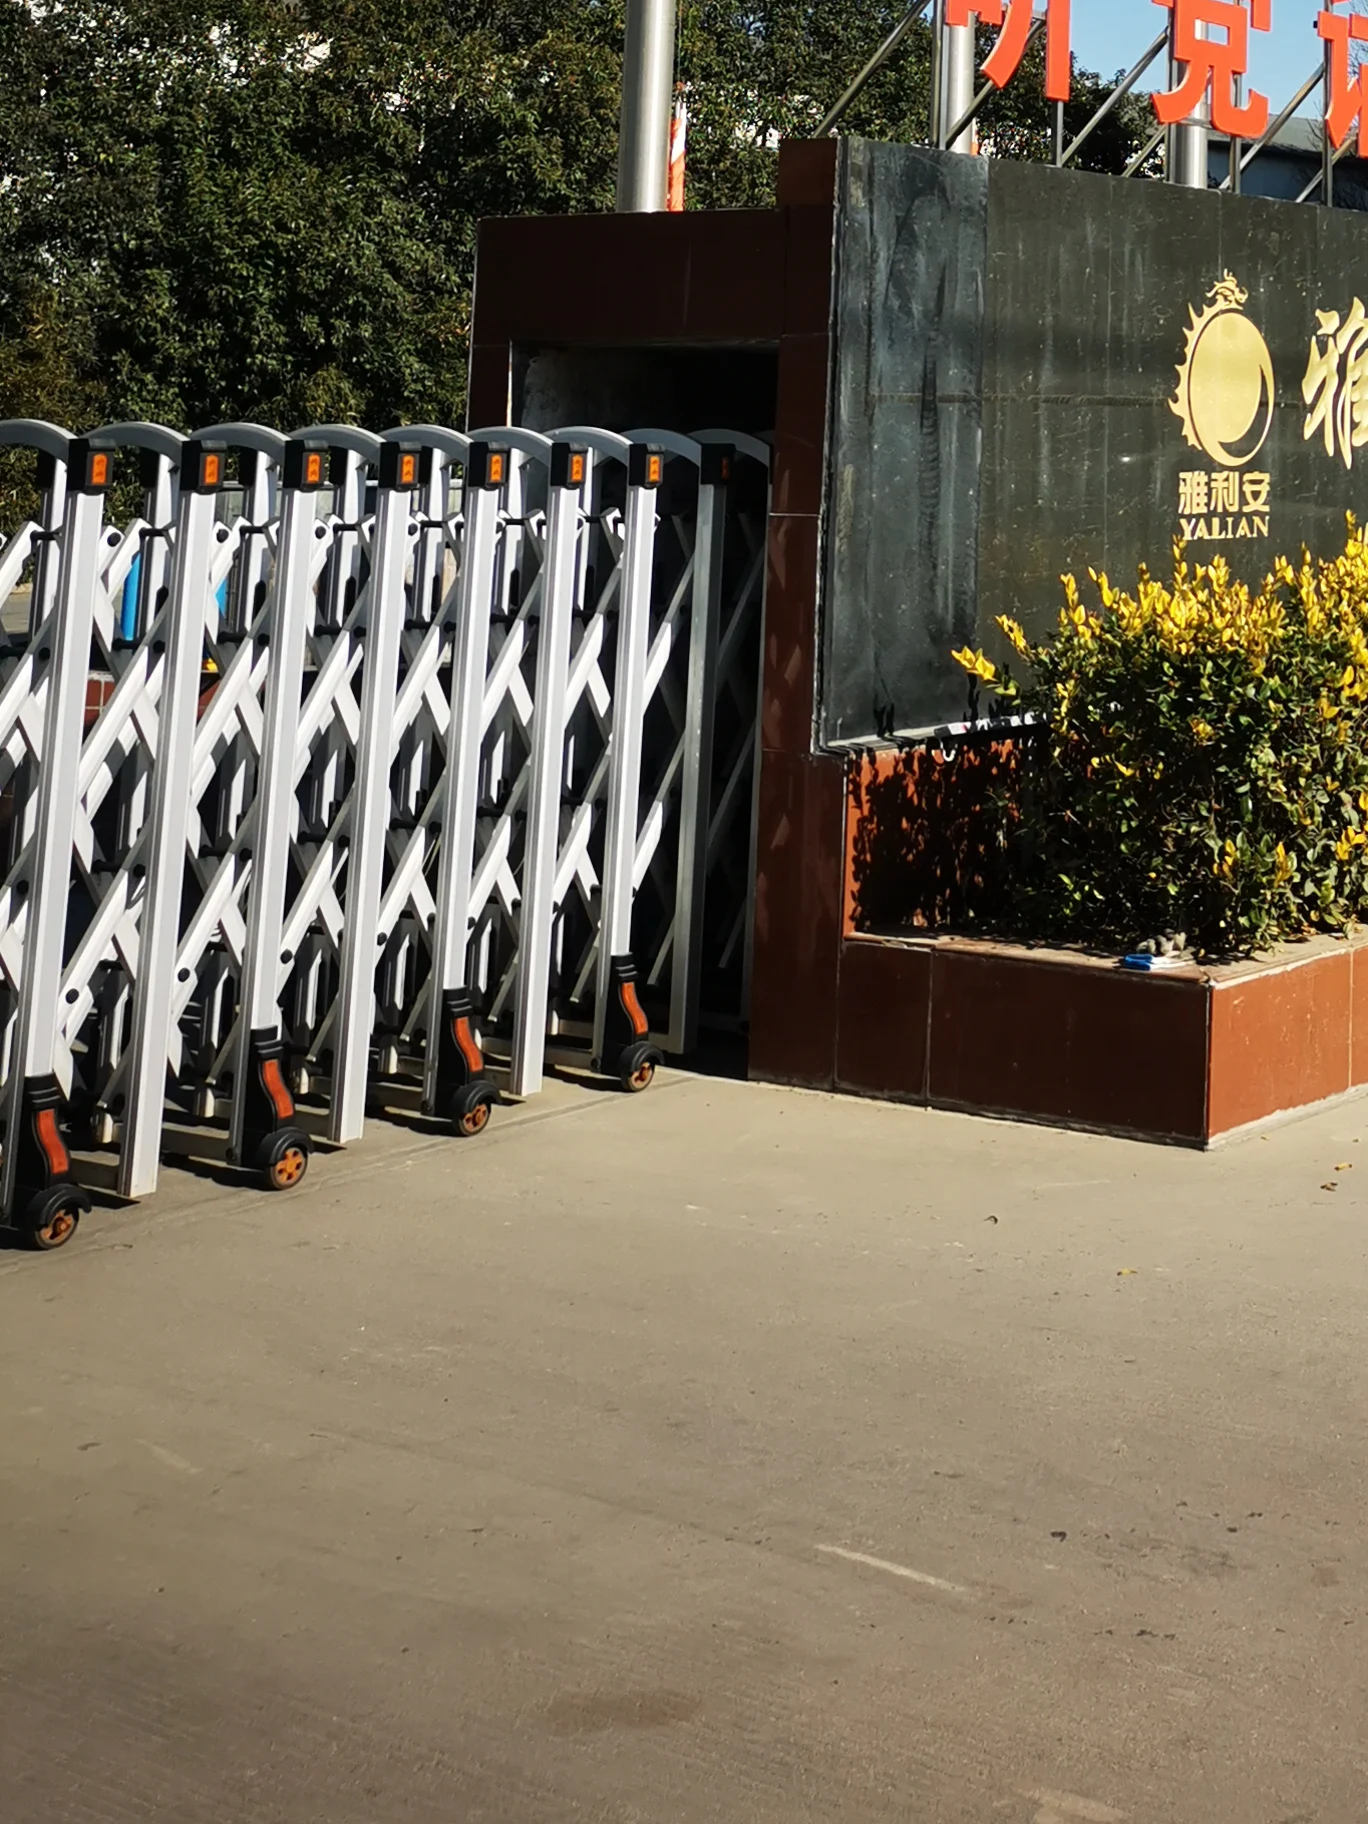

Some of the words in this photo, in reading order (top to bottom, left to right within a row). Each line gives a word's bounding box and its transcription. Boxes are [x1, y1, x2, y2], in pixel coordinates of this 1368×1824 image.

[1178, 471, 1271, 515] 雅利安
[1179, 515, 1270, 541] YALIAN
